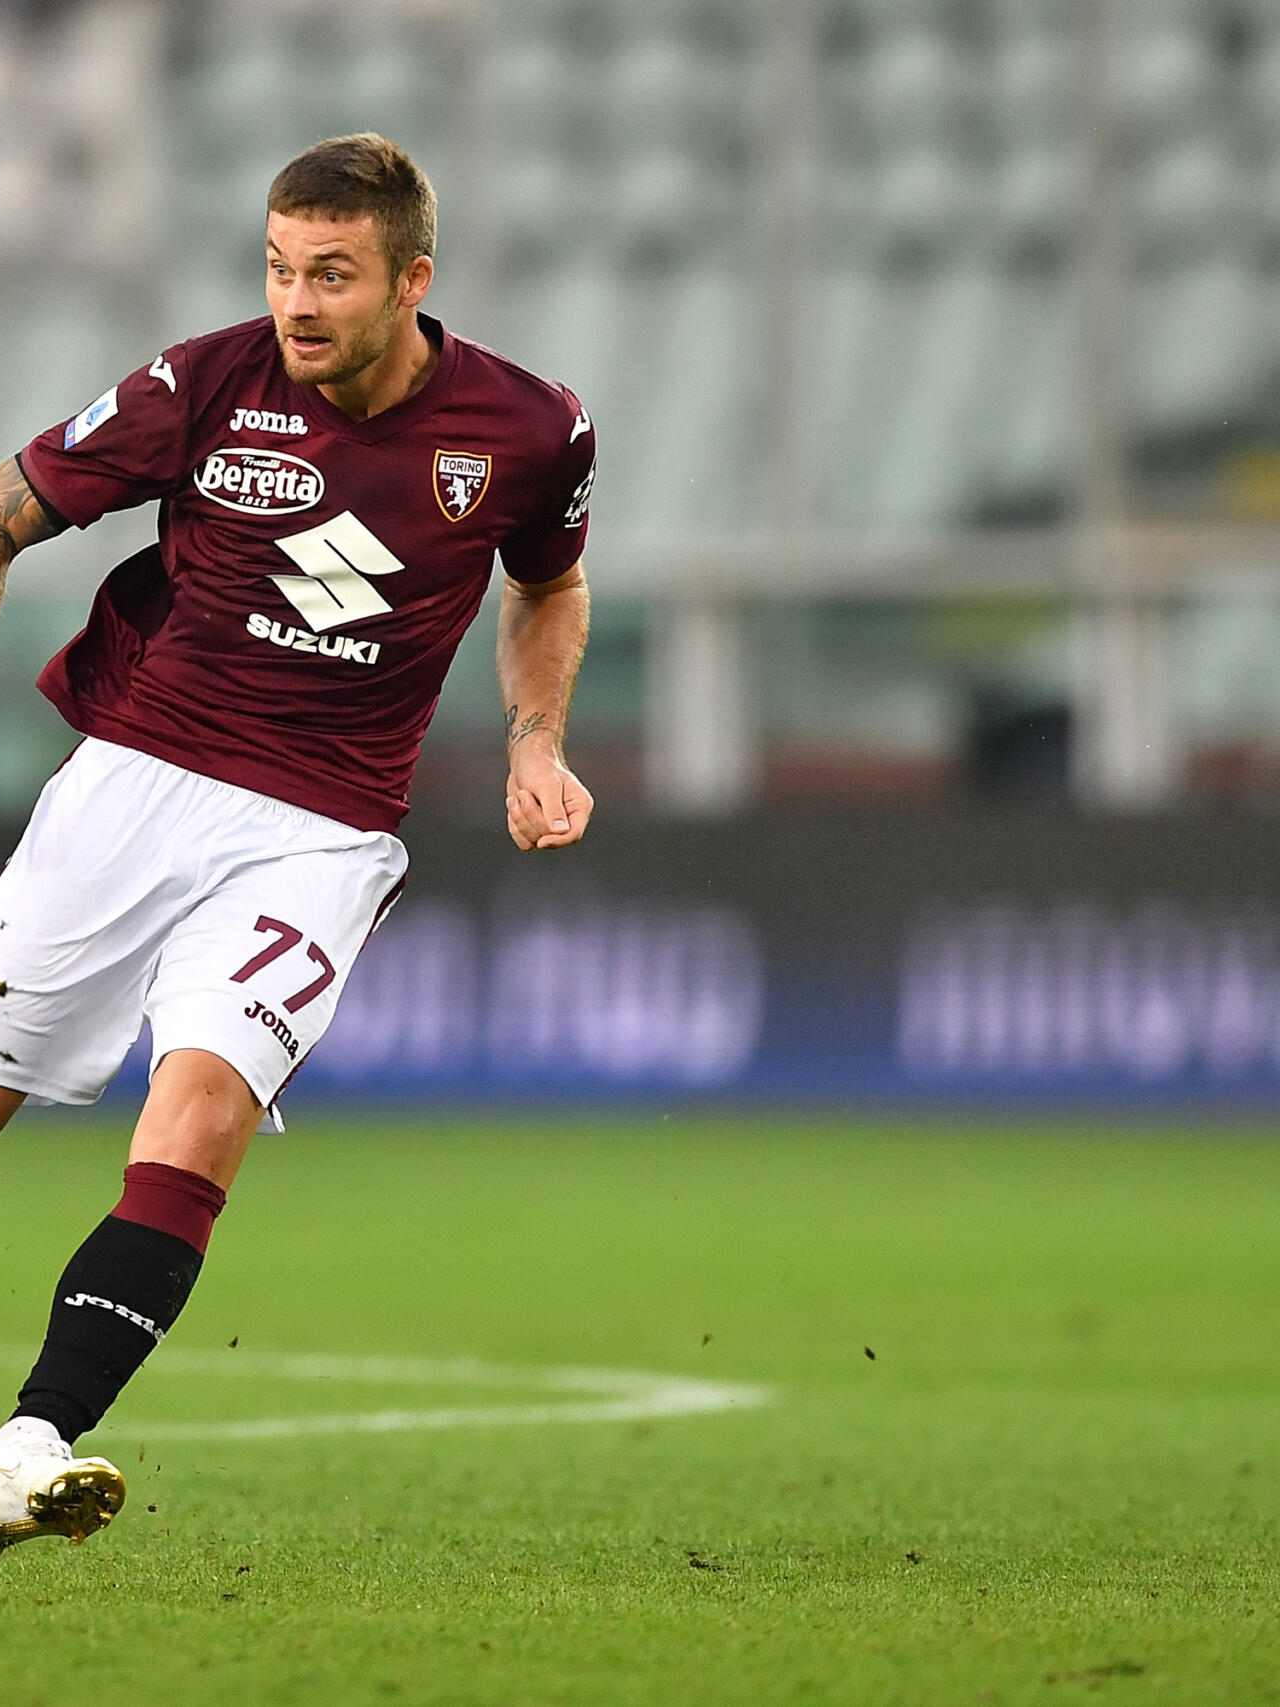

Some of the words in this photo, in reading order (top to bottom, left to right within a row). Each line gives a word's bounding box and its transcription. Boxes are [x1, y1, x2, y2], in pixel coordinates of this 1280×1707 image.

[200, 456, 317, 502] Beretta
[443, 459, 483, 474] TORINO
[466, 477, 481, 489] FC
[237, 495, 270, 508] 1812
[246, 613, 381, 665] SUZUKI
[229, 915, 336, 1015] 77
